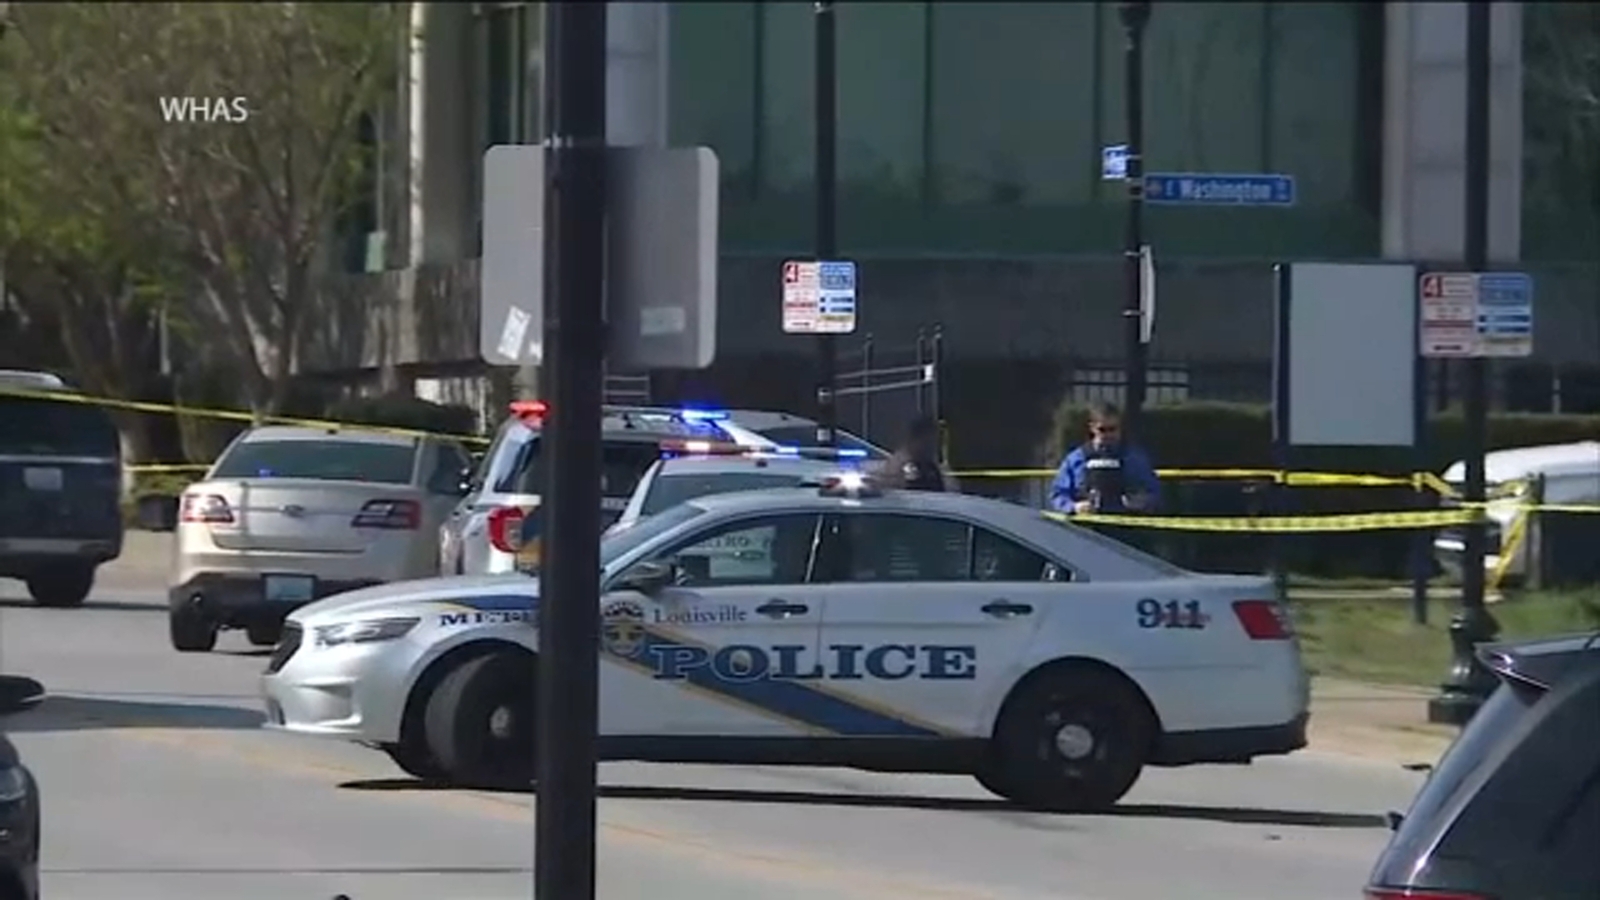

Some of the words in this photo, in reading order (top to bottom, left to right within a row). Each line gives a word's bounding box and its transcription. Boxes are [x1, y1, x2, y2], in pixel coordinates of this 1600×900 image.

[1179, 178, 1272, 201] Washington
[653, 604, 748, 623] Louisville
[1136, 597, 1205, 629] 911
[652, 643, 977, 681] POLICE
